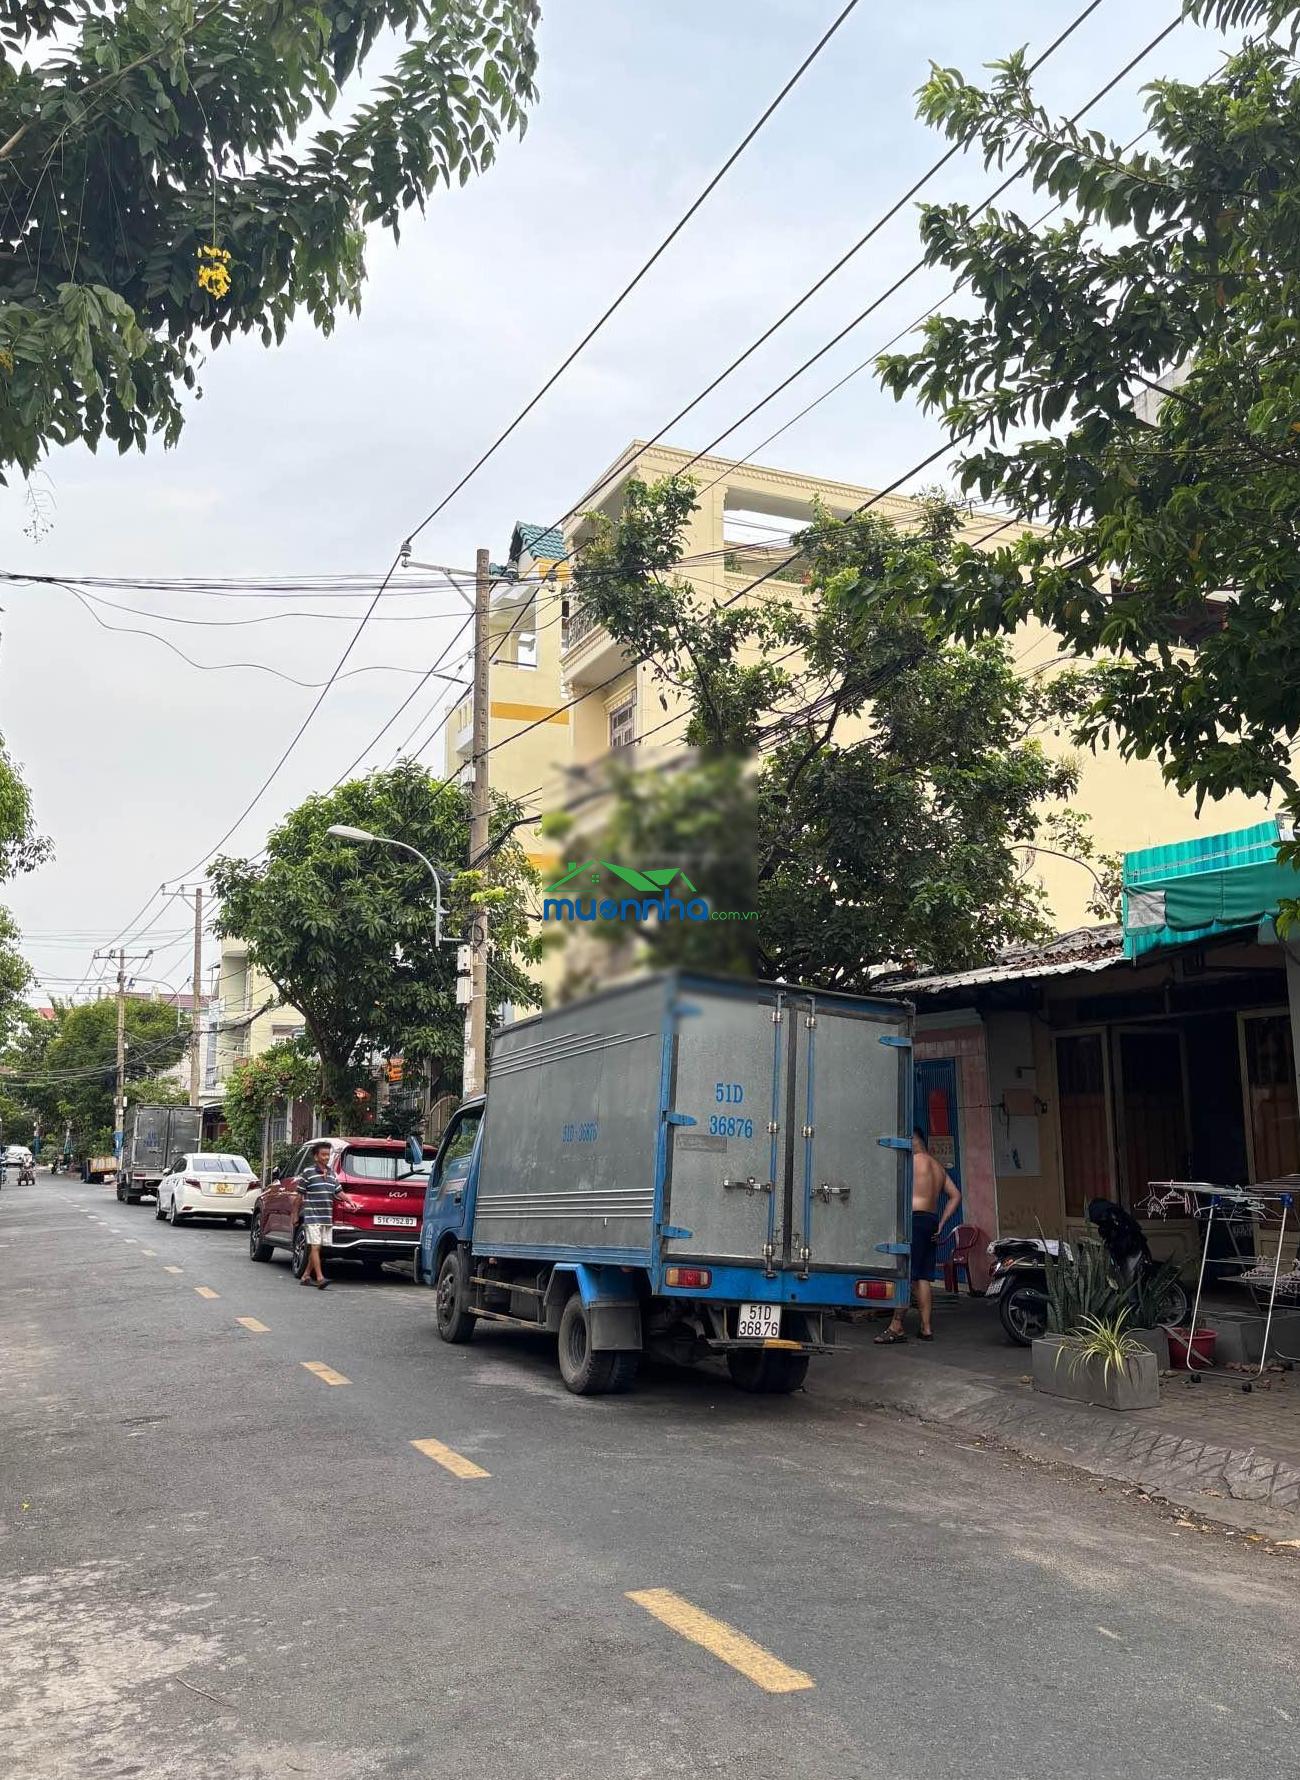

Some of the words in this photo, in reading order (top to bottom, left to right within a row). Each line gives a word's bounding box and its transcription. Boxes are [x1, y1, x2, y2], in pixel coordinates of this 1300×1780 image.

[715, 1083, 743, 1103] 51D
[709, 1115, 753, 1138] 36876
[749, 1305, 771, 1320] 51D
[740, 1321, 778, 1336] 368.76
